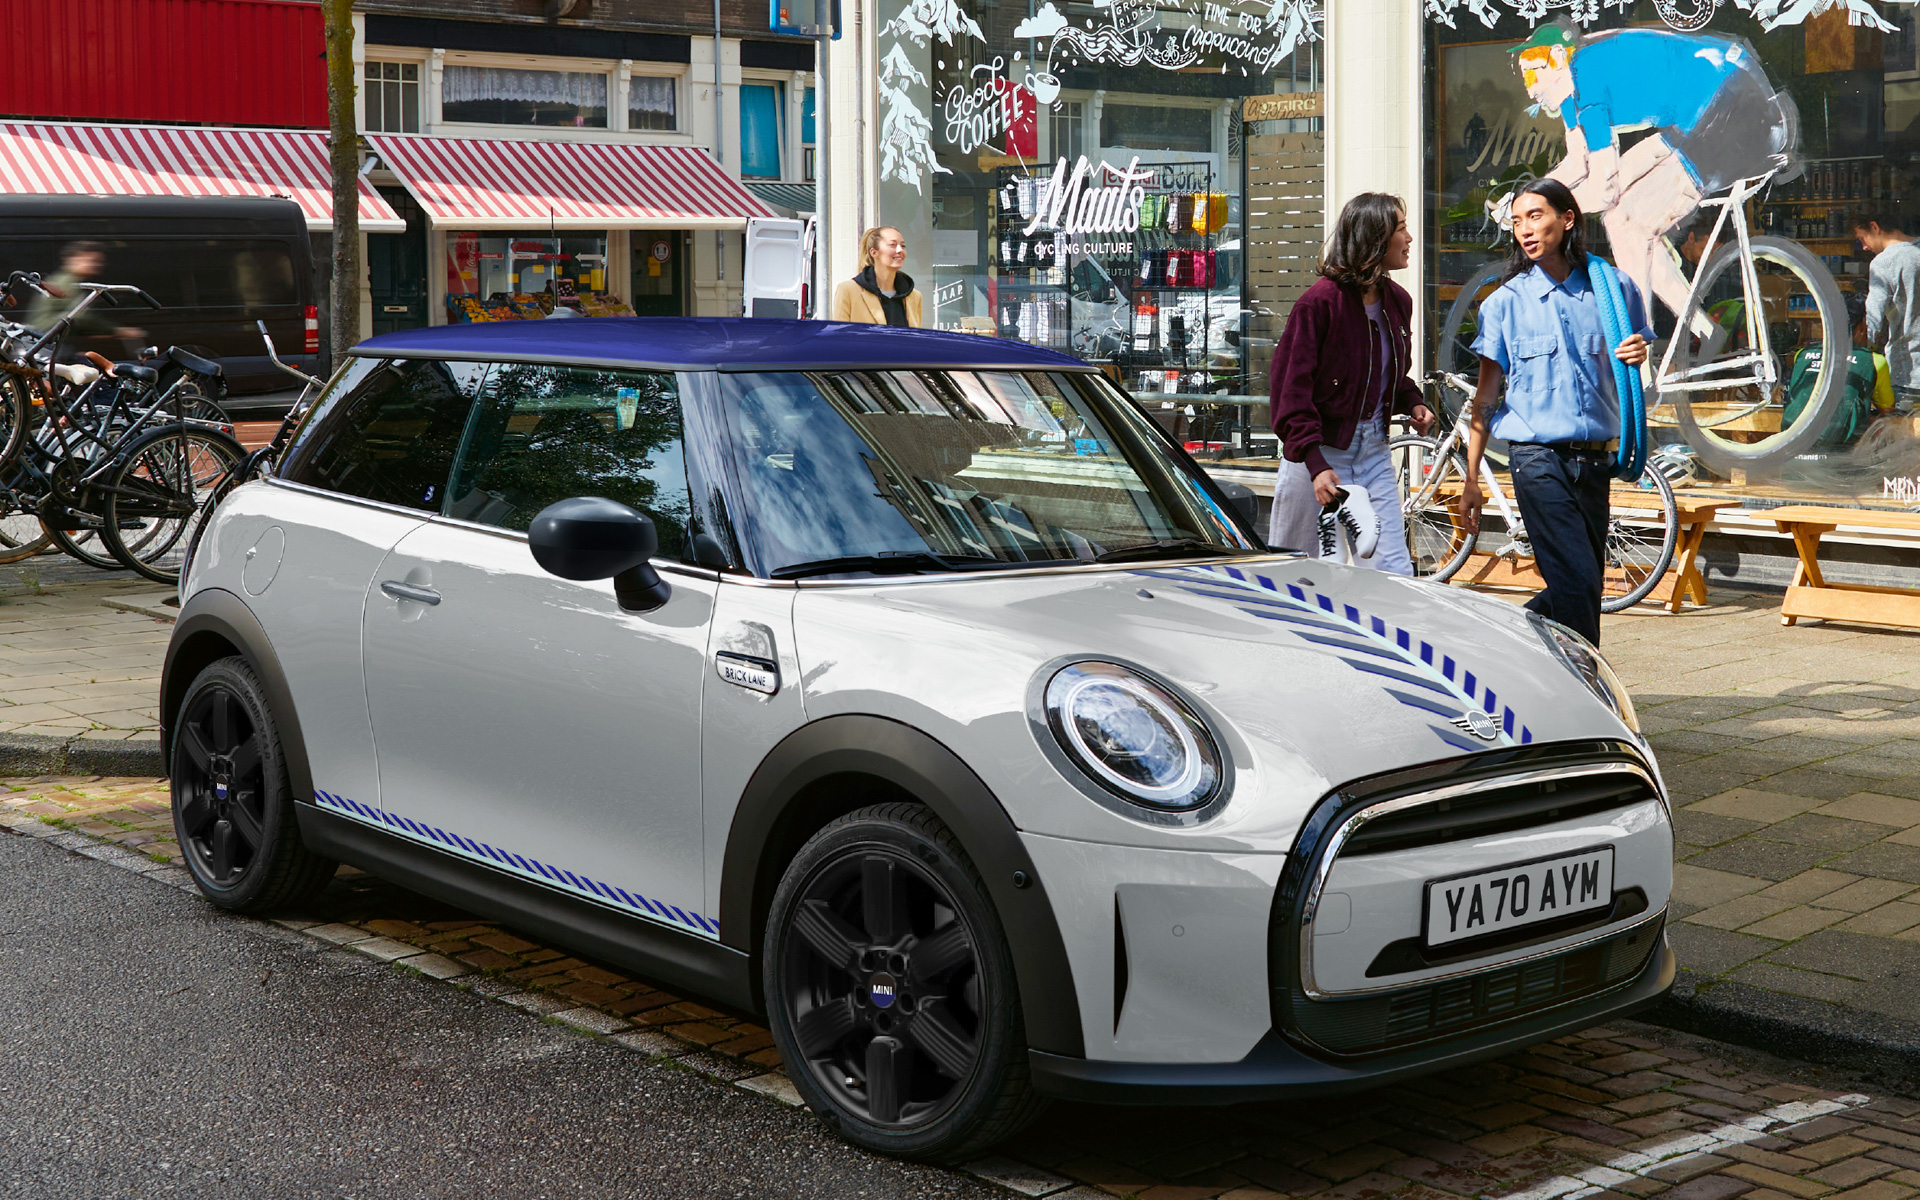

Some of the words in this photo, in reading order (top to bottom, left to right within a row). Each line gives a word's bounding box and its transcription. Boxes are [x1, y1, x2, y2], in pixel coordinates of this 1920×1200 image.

[1119, 3, 1152, 28] RIDES
[1205, 2, 1231, 26] TIME
[1238, 11, 1262, 36] FOR
[1182, 24, 1275, 65] Cappuccino
[945, 56, 1005, 143] Good
[960, 83, 1023, 154] COFFEE
[1023, 155, 1154, 237] Maats
[1083, 243, 1133, 254] CULTURE
[725, 667, 746, 681] BRICK
[748, 673, 766, 686] LANE
[1446, 874, 1530, 933] YA70
[1539, 860, 1600, 912] AYM
[872, 984, 893, 996] MINI
